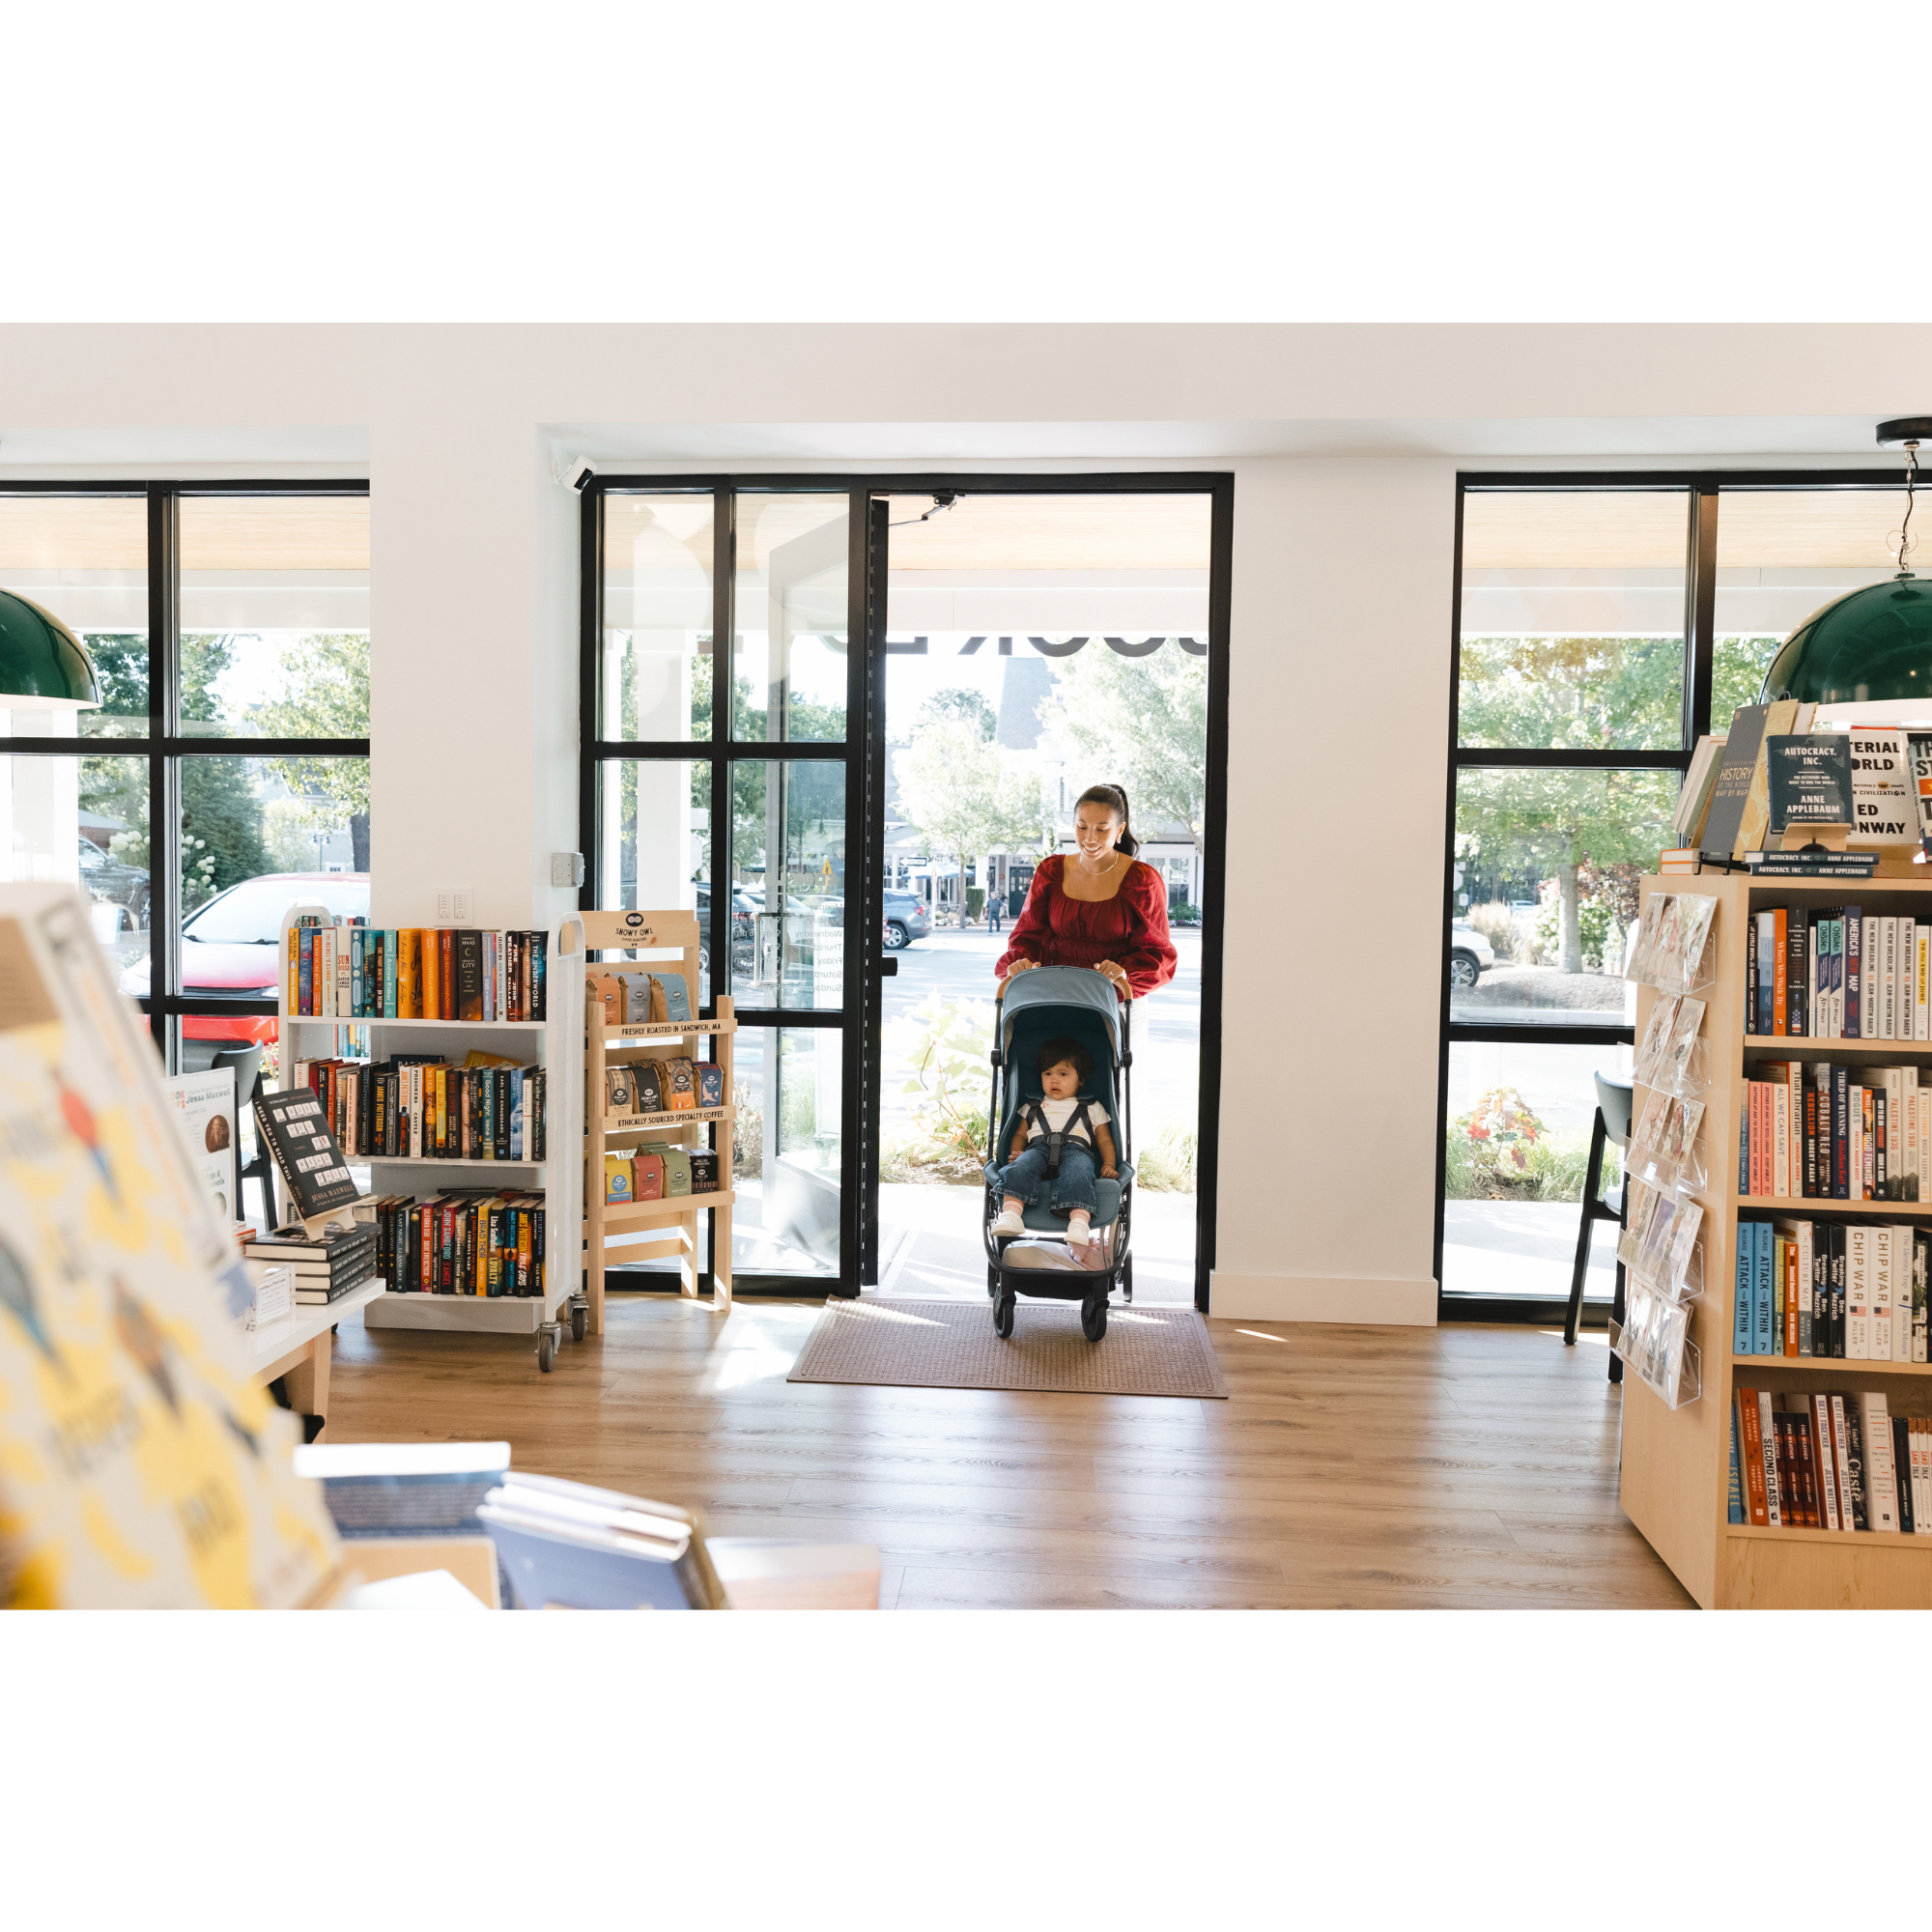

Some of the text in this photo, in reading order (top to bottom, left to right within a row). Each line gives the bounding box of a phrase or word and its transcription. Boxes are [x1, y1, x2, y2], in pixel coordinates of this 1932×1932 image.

[1719, 767, 1754, 781] HISTORY
[1852, 758, 1893, 771] ORLD
[1857, 804, 1878, 815] ED
[615, 927, 638, 937] SNOWY
[1849, 918, 1859, 955] AMERICA'S
[338, 955, 350, 964] SUN
[1849, 957, 1858, 974] NEW
[1776, 965, 1783, 975] We
[1848, 976, 1858, 991] MAP
[1776, 997, 1783, 1006] By
[185, 1088, 231, 1103] Jessa Maxwell
[1837, 1094, 1845, 1103] OF
[618, 1117, 647, 1126] ETHICALLY
[649, 1115, 674, 1124] SOURCED
[676, 1113, 703, 1122] SPECIALTY
[1777, 1104, 1785, 1116] WE
[1819, 1096, 1829, 1154] COBALT RED
[257, 1105, 267, 1122] NEED
[271, 1138, 277, 1147] TO
[274, 1148, 284, 1165] READ
[282, 1166, 292, 1180] THIS
[1863, 1132, 1872, 1151] HOOD
[311, 1193, 328, 1204] JESSA
[328, 1184, 355, 1198] MAXWELL
[489, 1258, 497, 1285] LOYALTY
[1854, 1233, 1863, 1300] CHIP WAR
[1878, 1234, 1889, 1301] CHIP WAR
[1739, 1256, 1748, 1333] ATTACK WITHIN
[1760, 1256, 1769, 1333] ATTACK WITHIN
[1819, 1420, 1830, 1448] TOGETHER
[1835, 1420, 1845, 1449] TOGETHER
[1764, 1438, 1776, 1475] SECOND
[1824, 1469, 1833, 1487] JESSE
[1840, 1469, 1849, 1487] JESSE
[1848, 1459, 1861, 1502] Caste
[1766, 1478, 1777, 1506] CLASS
[1826, 1488, 1835, 1514] WATTERS
[1841, 1489, 1852, 1515] WATTERS
